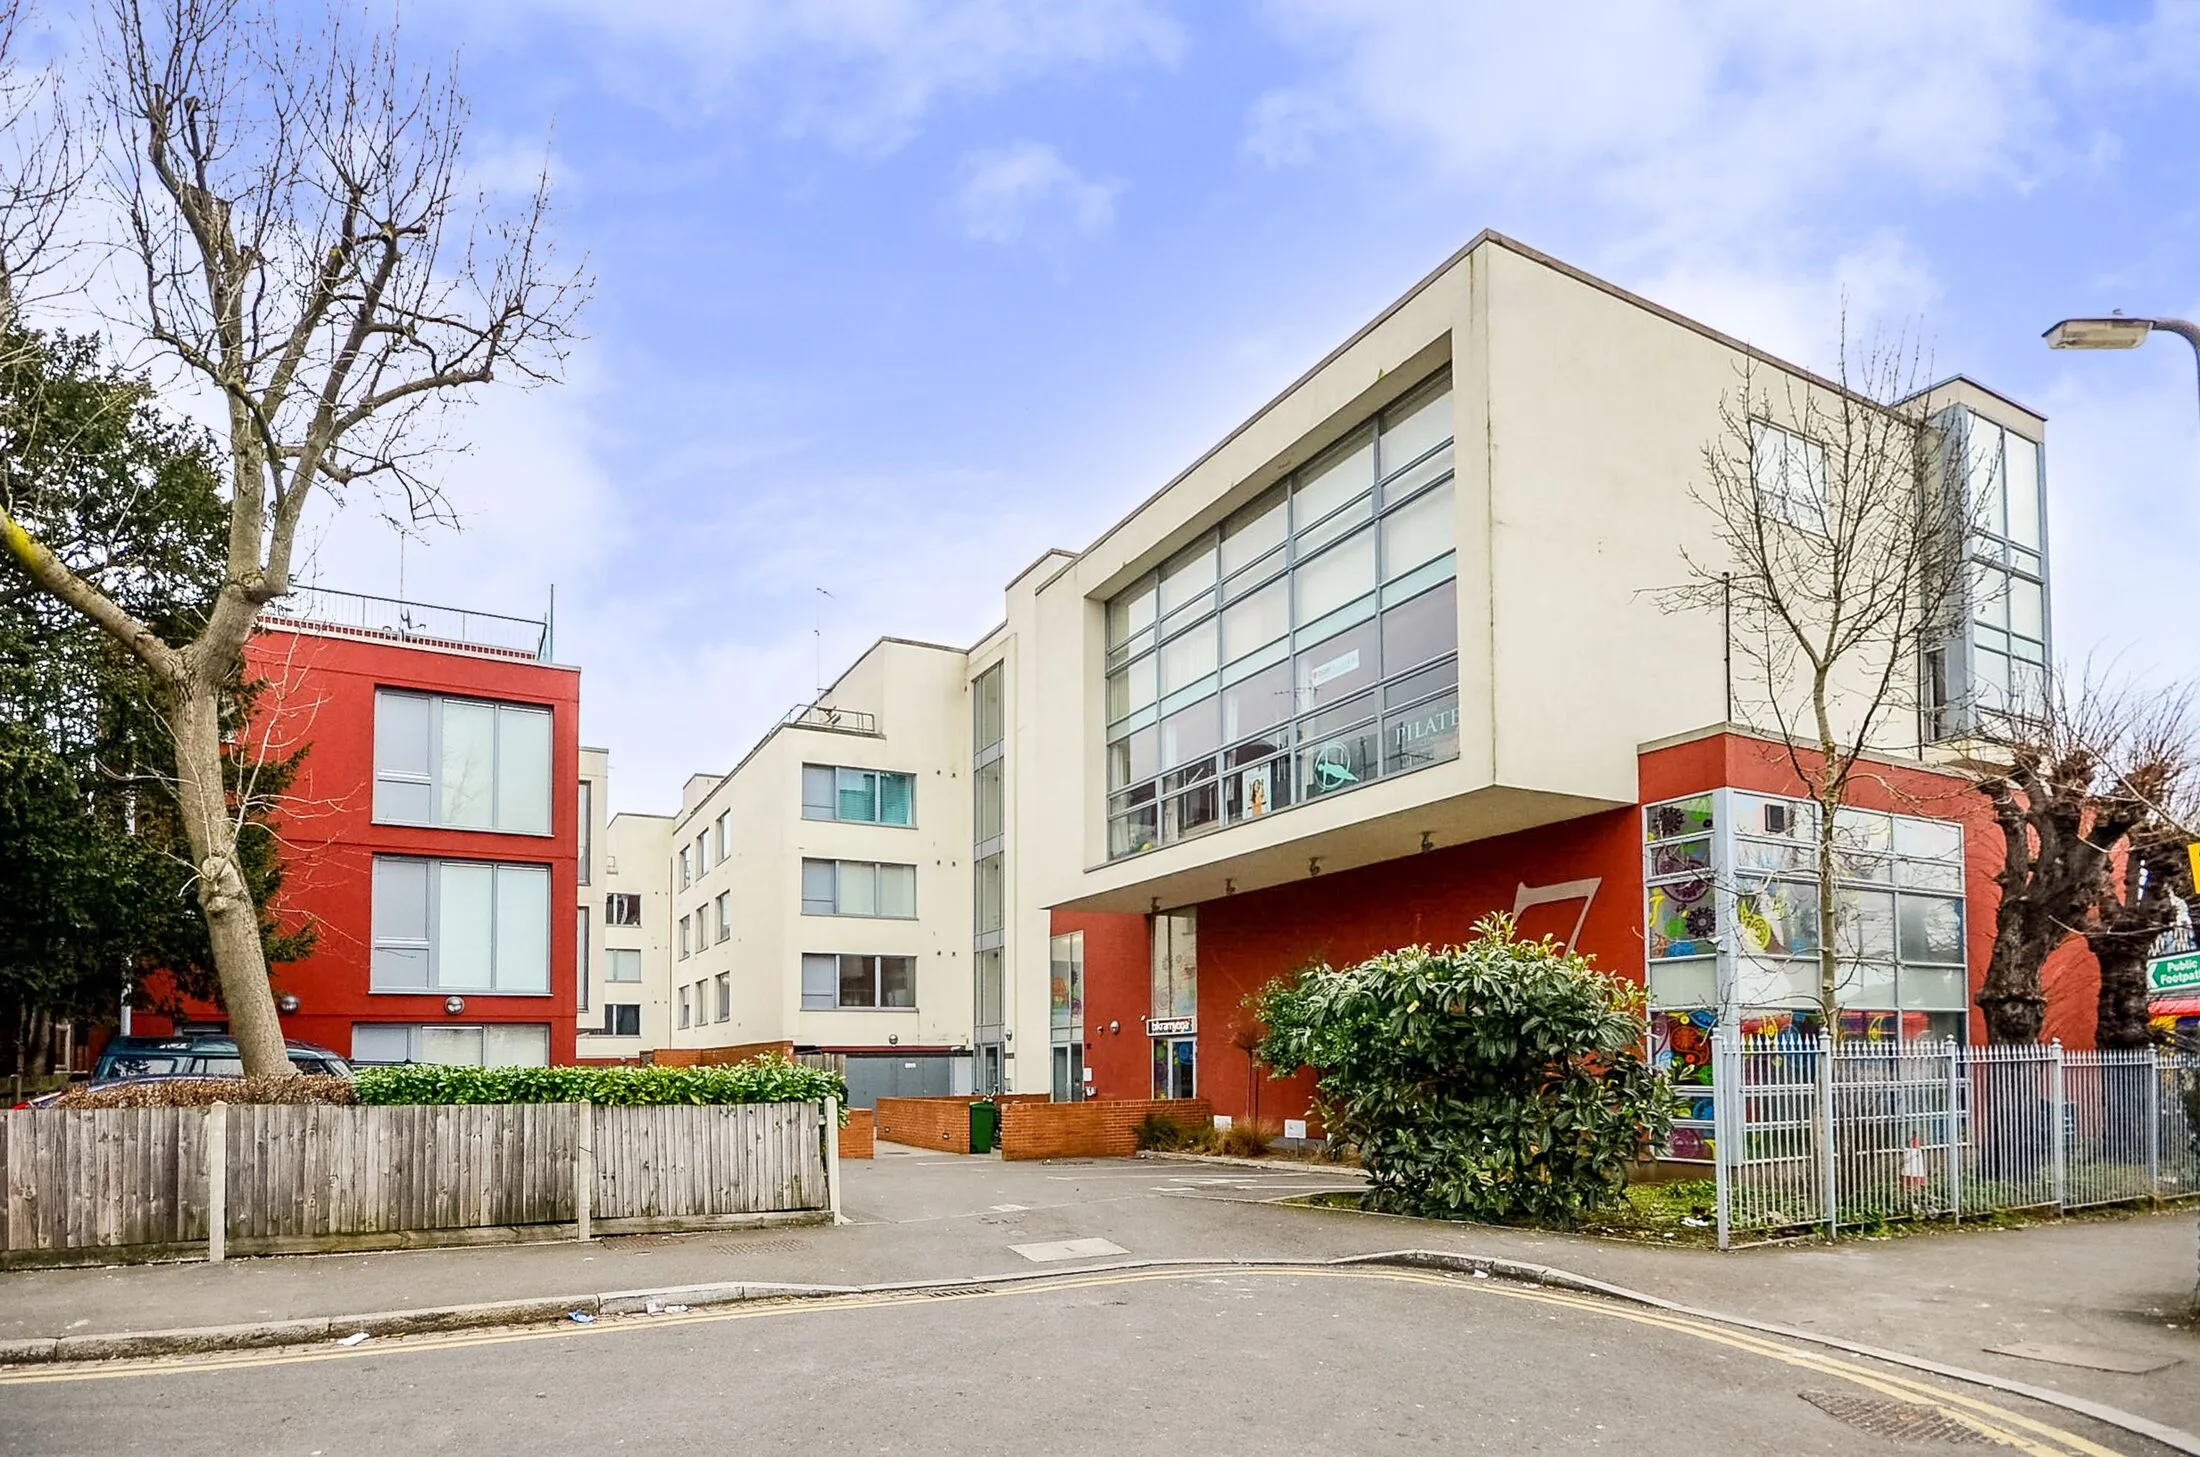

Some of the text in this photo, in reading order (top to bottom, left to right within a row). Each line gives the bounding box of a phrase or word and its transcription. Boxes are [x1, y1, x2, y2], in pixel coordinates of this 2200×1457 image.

[1513, 876, 1602, 960] 7
[2167, 959, 2198, 972] Public
[2160, 968, 2200, 985] Footpat
